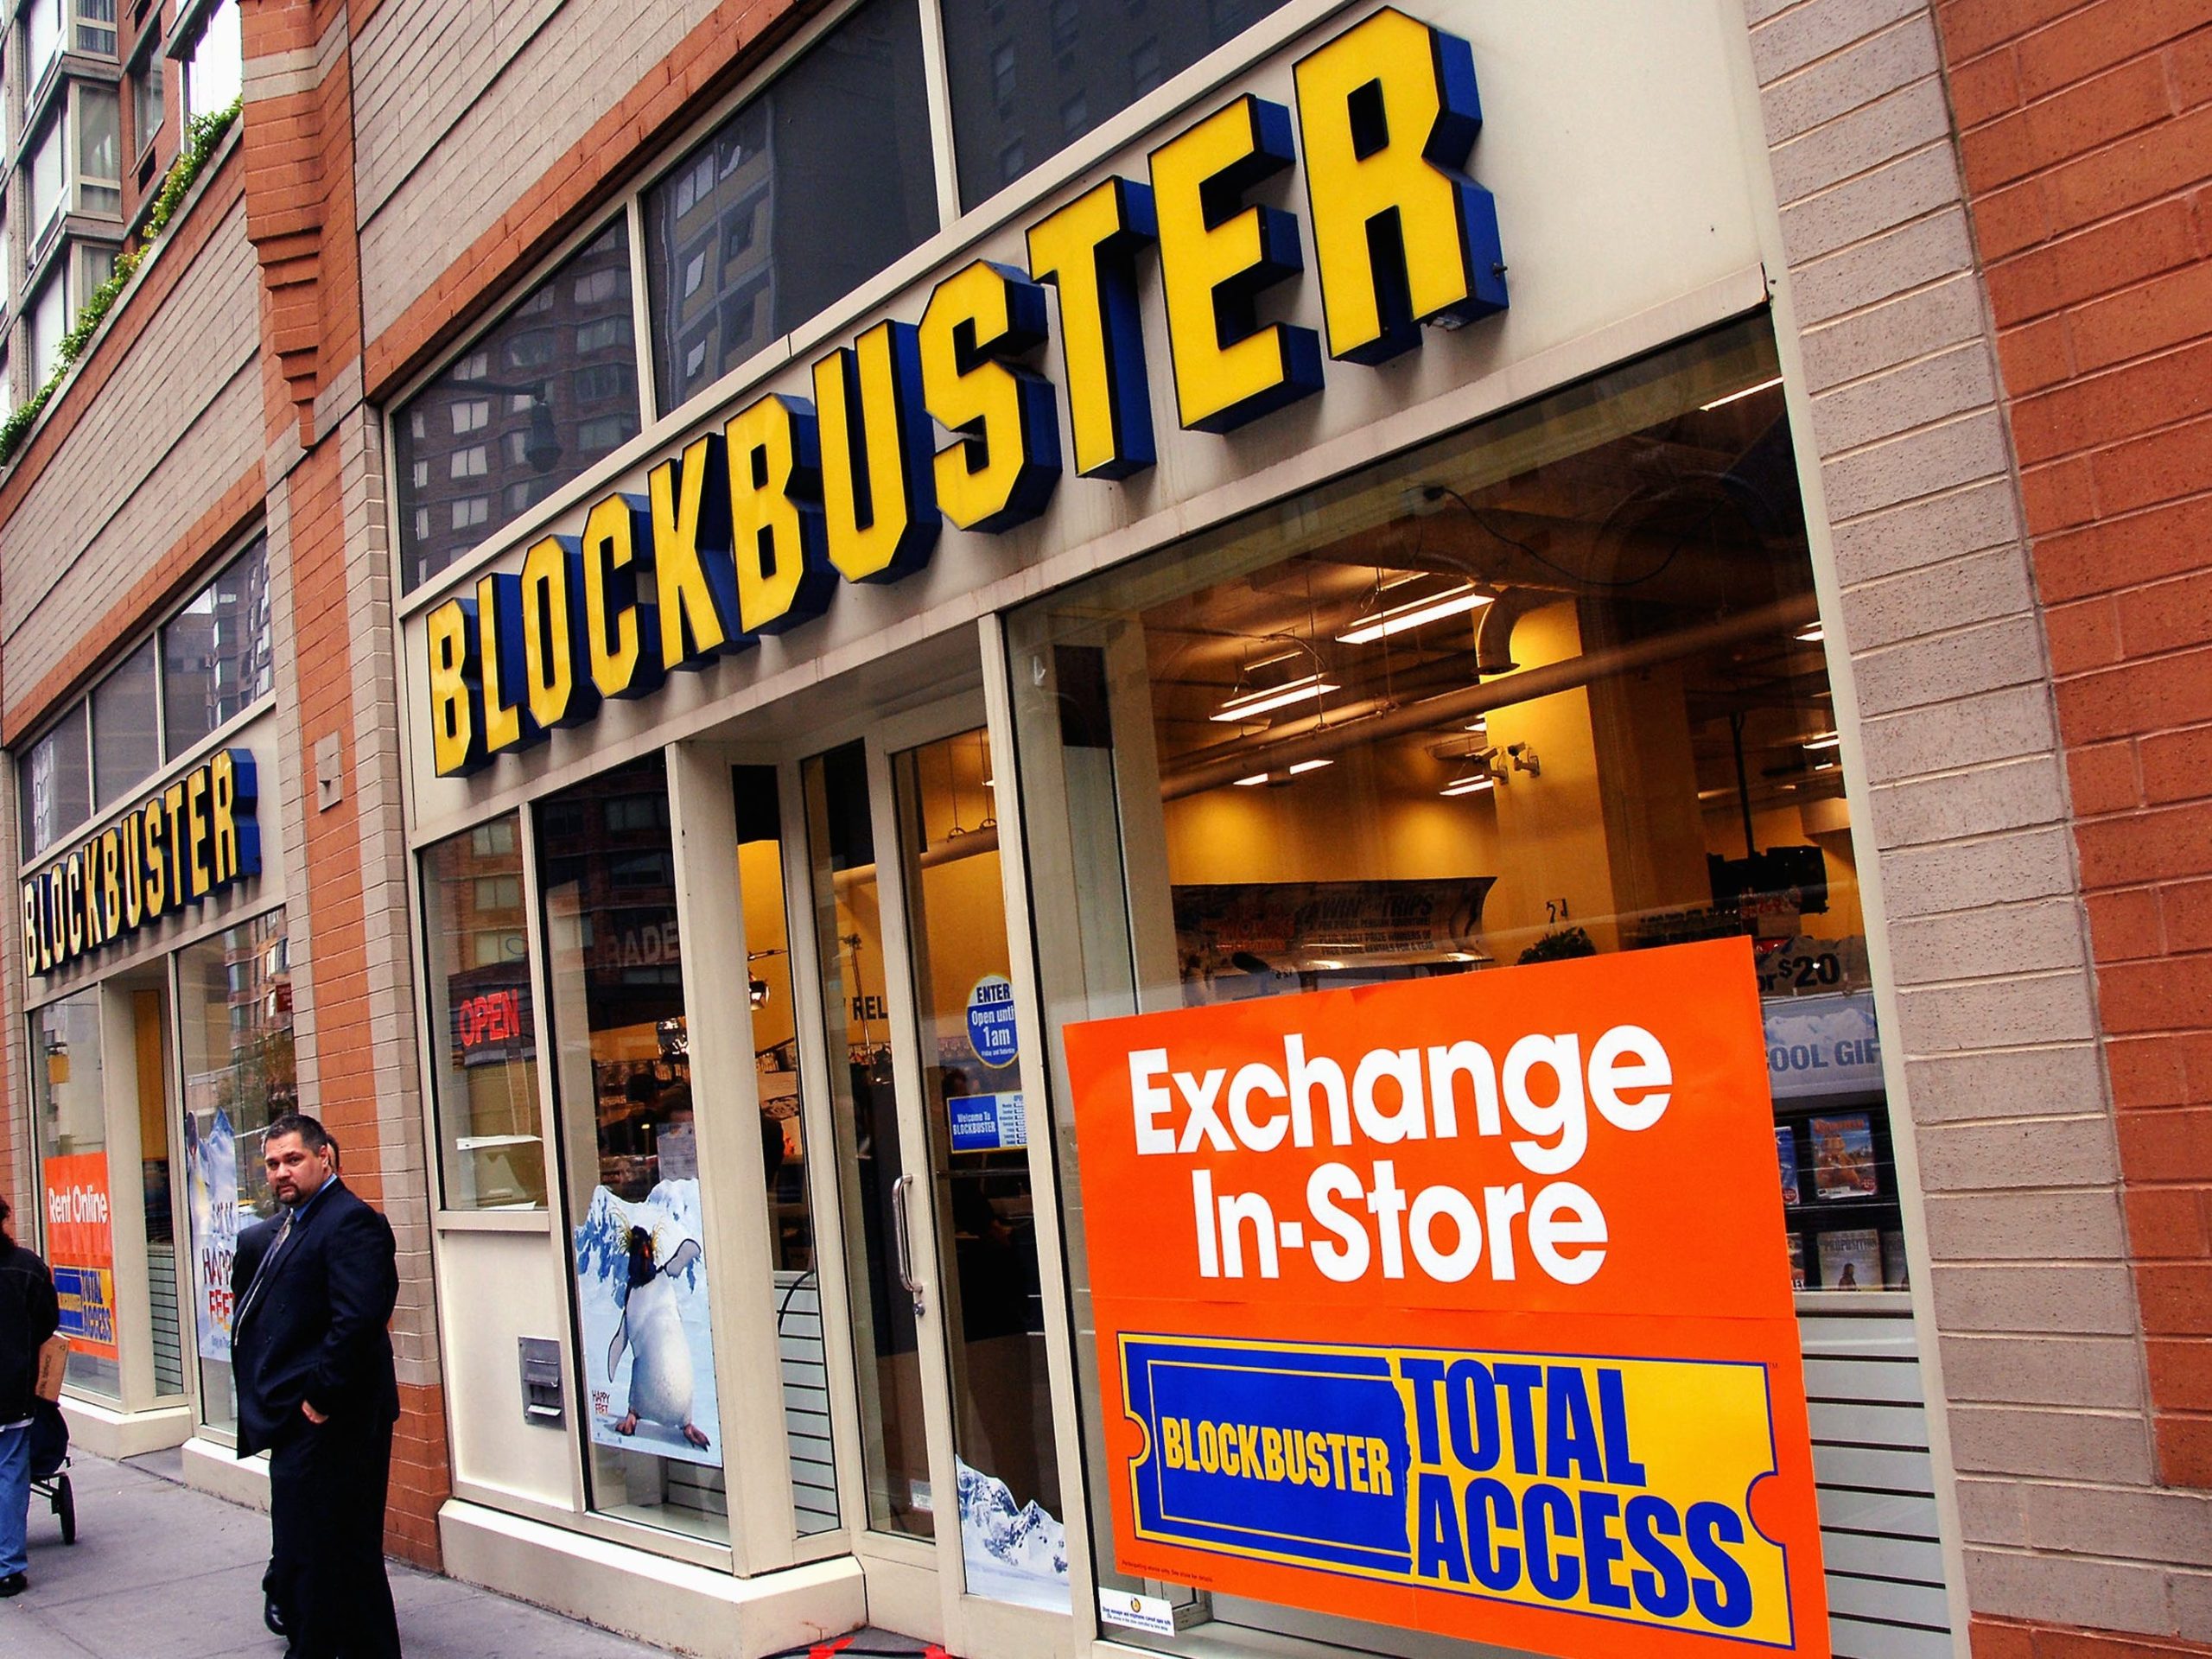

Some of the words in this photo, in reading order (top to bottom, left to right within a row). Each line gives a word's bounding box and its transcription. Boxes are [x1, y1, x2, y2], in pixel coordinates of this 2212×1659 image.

[427, 5, 1509, 778] BLOCKBUSTER
[23, 748, 262, 977] BLOCKBUSTER
[976, 983, 1011, 1003] ENTER
[1777, 953, 1841, 988] $20
[459, 988, 520, 1047] OPEN
[971, 1010, 995, 1027] Open
[982, 1027, 1010, 1047] 1am
[1764, 1046, 1829, 1072] OOL
[1128, 1025, 1673, 1175] Exchange
[952, 1122, 996, 1135] BLOCKBUSTER
[48, 1187, 71, 1224] Rent
[72, 1185, 108, 1224] Online
[1192, 1160, 1609, 1285] In-Store
[202, 1247, 234, 1286] HAPP
[1401, 1358, 1647, 1486] TOTAL
[1161, 1416, 1394, 1497] BLOCKBUSTER
[1417, 1474, 1753, 1628] ACCESS
